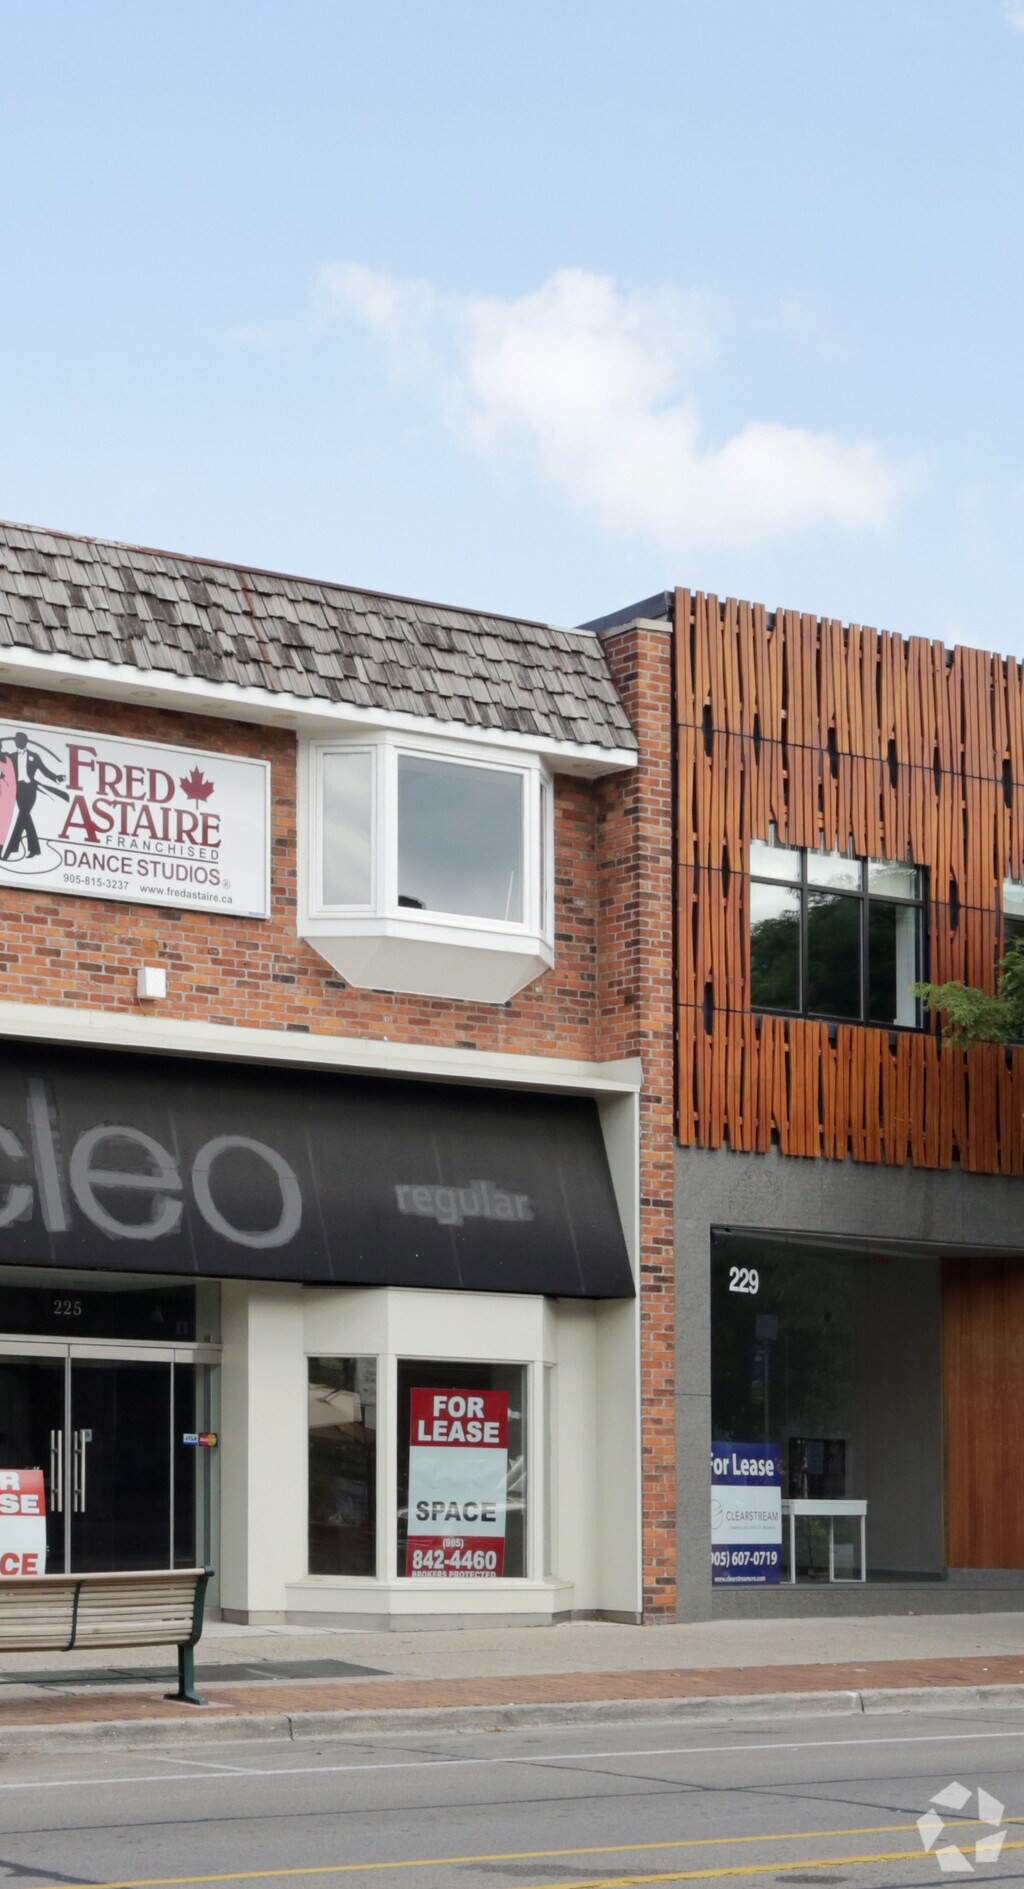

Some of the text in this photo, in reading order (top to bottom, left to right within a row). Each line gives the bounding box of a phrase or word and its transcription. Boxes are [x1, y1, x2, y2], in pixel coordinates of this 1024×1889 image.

[65, 743, 175, 804] FRED
[58, 795, 222, 848] ASTAIRE
[106, 835, 219, 860] FRANCHISED
[63, 849, 133, 875] DANCE
[63, 874, 233, 904] 905-815-3237 www.fredastaire.ca
[395, 1181, 530, 1224] regular
[729, 1266, 760, 1295] 229
[53, 1301, 82, 1316] 225
[432, 1395, 484, 1418] FOR
[417, 1419, 500, 1443] LEASE
[732, 1453, 775, 1476] Lease
[416, 1501, 497, 1522] SPACE
[726, 1511, 779, 1522] CLEARSTREAM
[412, 1549, 497, 1570] 842-4460
[731, 1551, 778, 1566] 607-0719
